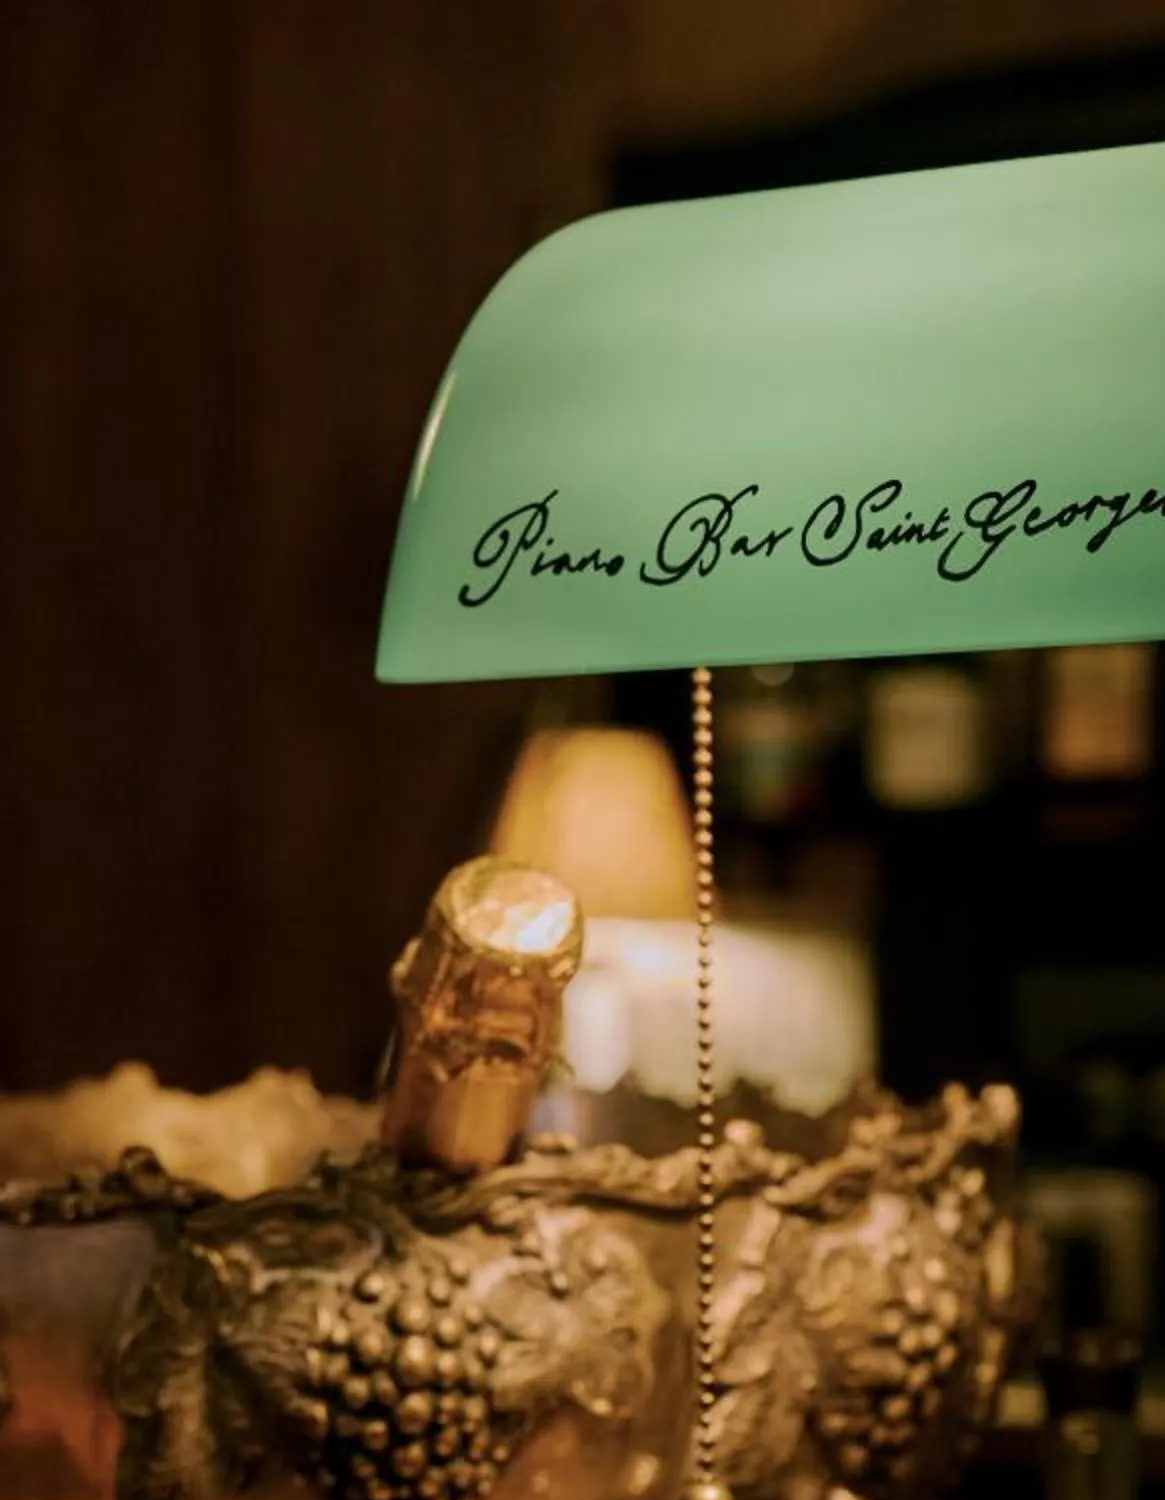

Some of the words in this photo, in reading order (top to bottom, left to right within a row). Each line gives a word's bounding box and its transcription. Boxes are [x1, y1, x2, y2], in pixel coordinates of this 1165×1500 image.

[457, 489, 625, 608] Piano
[639, 484, 795, 587] Bar
[800, 479, 951, 567] Saint
